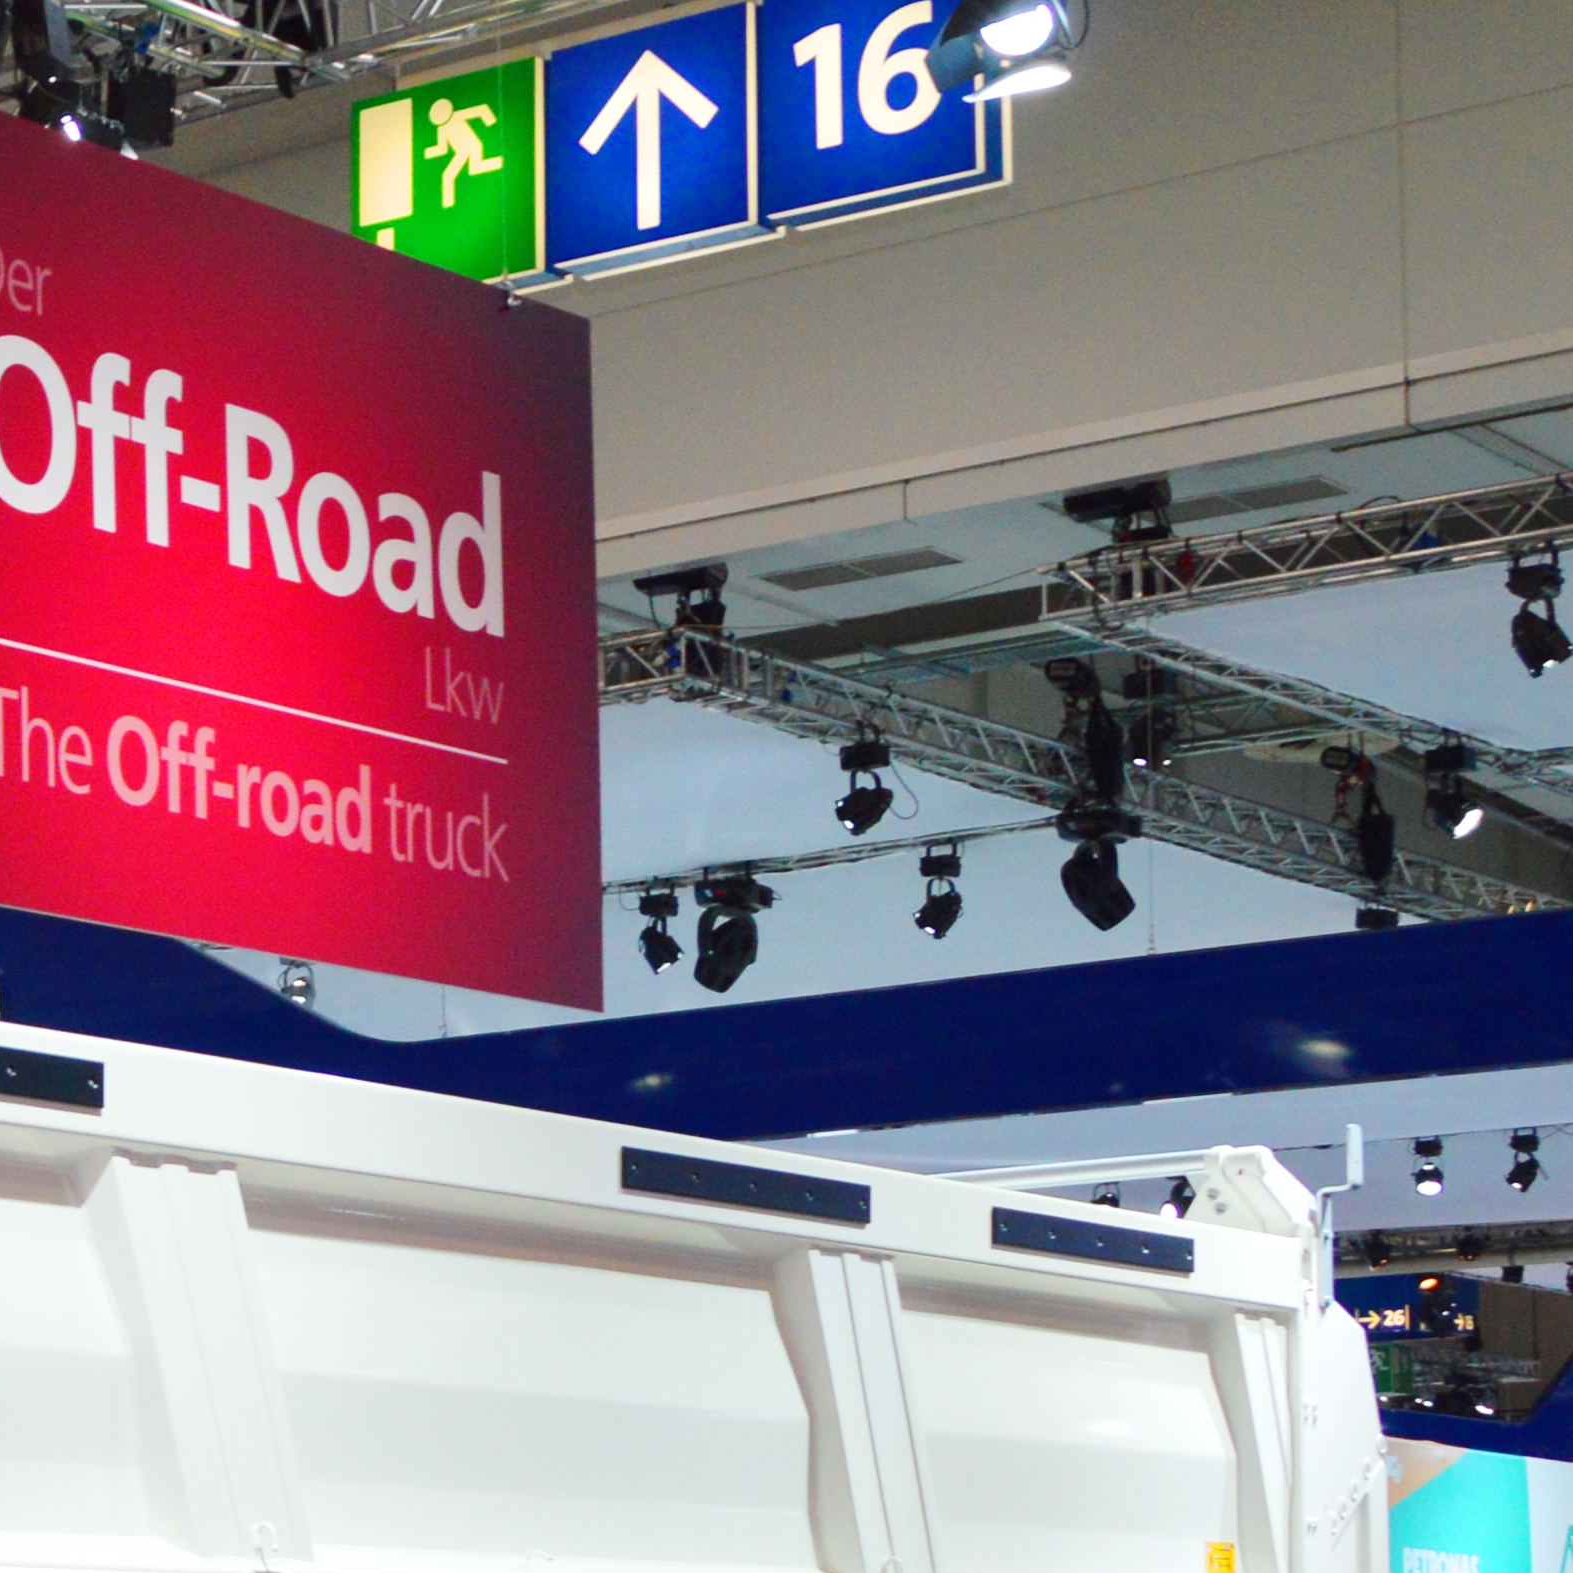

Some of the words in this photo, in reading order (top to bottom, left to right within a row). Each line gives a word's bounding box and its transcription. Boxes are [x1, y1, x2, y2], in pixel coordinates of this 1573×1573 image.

[793, 1, 942, 149] 16
[424, 647, 504, 724] Lkw
[106, 715, 371, 853] Off-road
[384, 783, 510, 881] truck
[1383, 1309, 1406, 1327] 26
